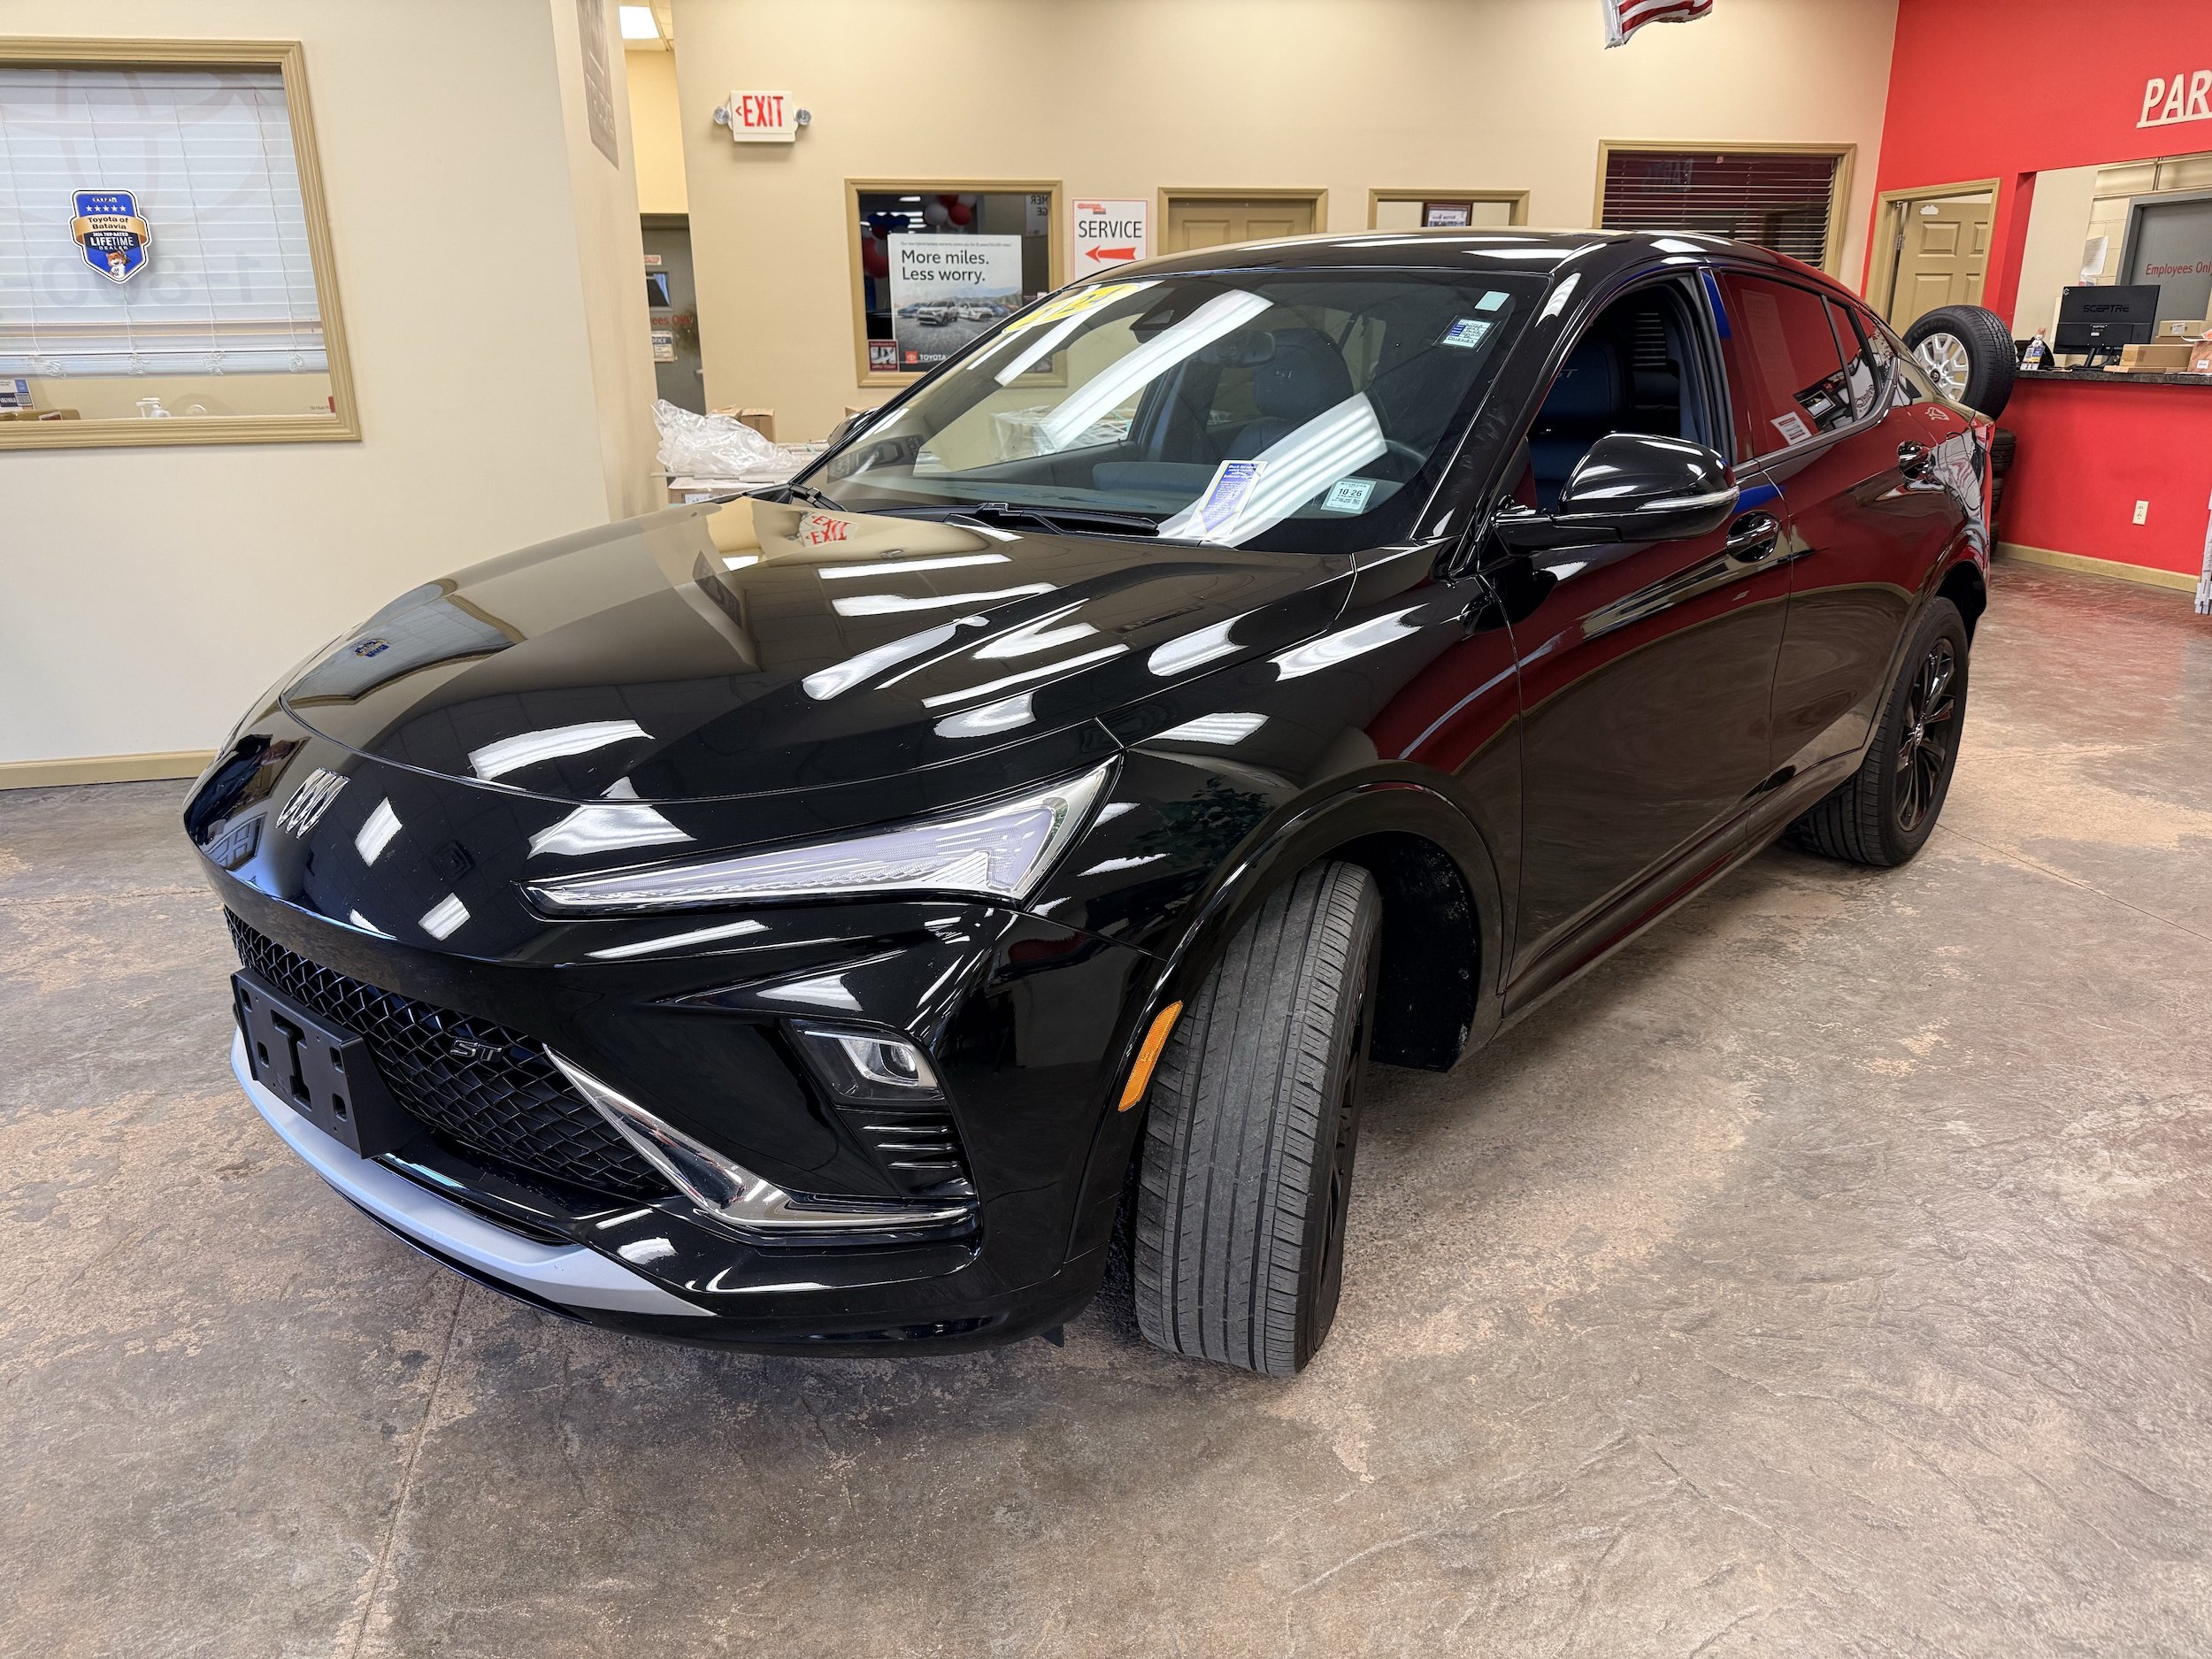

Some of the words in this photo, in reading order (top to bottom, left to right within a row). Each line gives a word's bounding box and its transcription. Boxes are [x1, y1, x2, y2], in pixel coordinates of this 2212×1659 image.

[2139, 69, 2212, 124] PAR
[742, 96, 784, 127] EXIT
[1079, 220, 1142, 239] SERVICE
[89, 236, 134, 247] LIFETIME
[902, 249, 941, 264] More
[946, 250, 989, 265] miles.
[902, 266, 934, 280] Less
[939, 269, 986, 285] worry.
[2146, 263, 2193, 278] Employees
[2196, 261, 2212, 276] Onl
[2083, 303, 2131, 313] SCEPTRE
[672, 314, 694, 326] Only
[450, 1039, 503, 1062] ST
